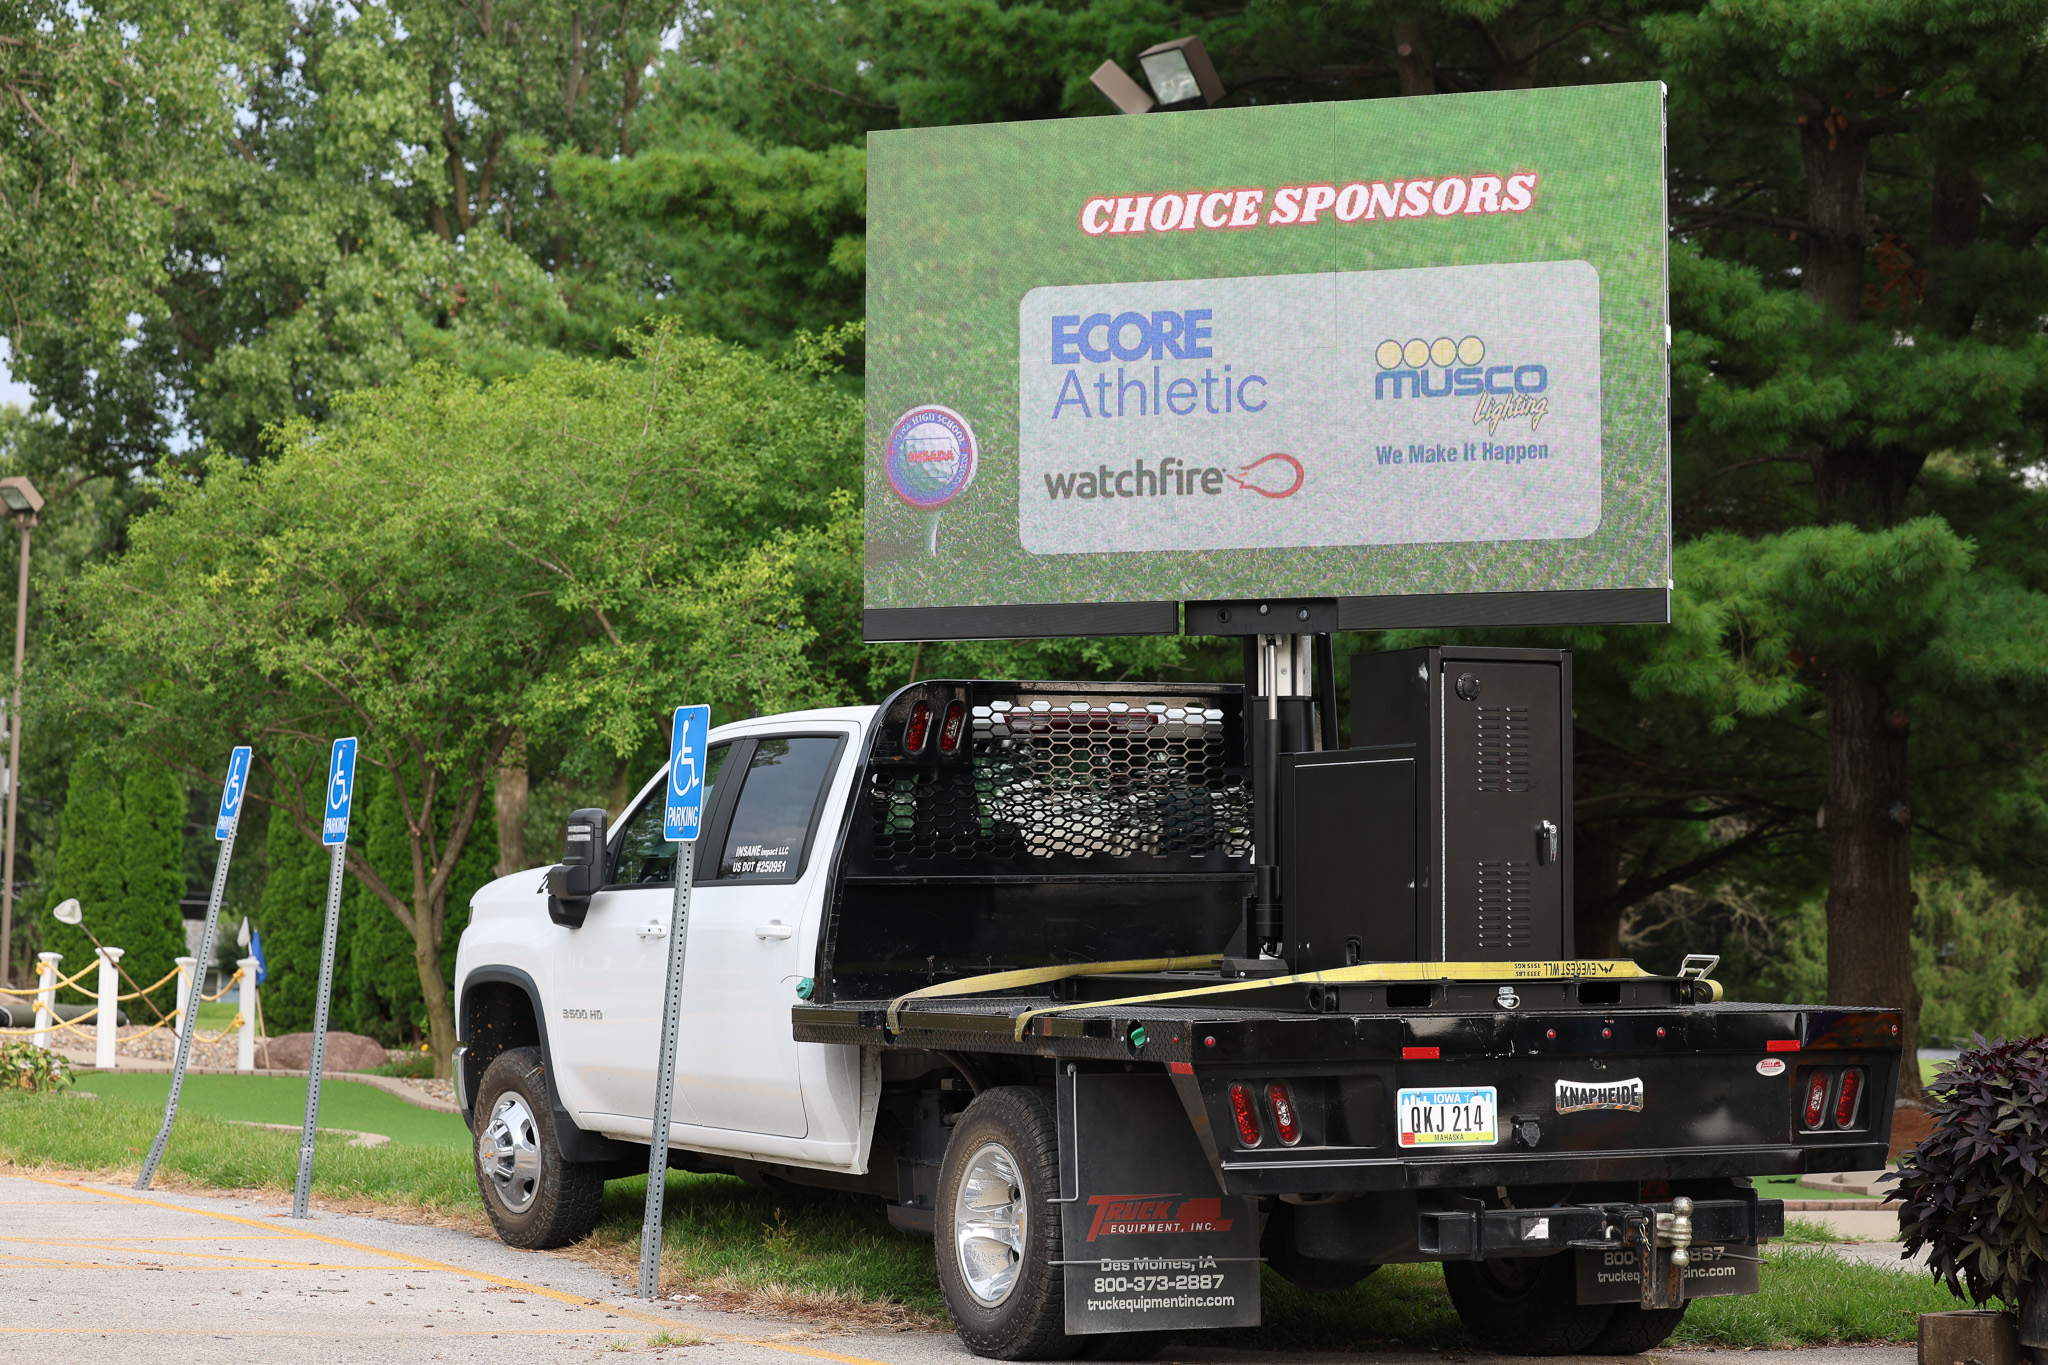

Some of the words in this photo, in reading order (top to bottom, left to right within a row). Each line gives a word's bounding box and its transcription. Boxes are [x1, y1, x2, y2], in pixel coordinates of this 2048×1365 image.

[1079, 189, 1266, 235] CHOICE
[1267, 172, 1538, 226] SPONSORS
[1051, 308, 1213, 365] ECORE
[1051, 364, 1268, 420] Athletic
[1472, 390, 1549, 438] Lighting
[1375, 445, 1403, 465] We
[1408, 443, 1458, 464] Make
[1463, 442, 1477, 462] It
[1482, 441, 1549, 465] Happen
[1043, 457, 1224, 500] watchfire
[325, 817, 347, 834] PARKING
[666, 805, 699, 827] PARKING
[735, 844, 762, 858] INSANE
[761, 847, 779, 858] impact
[778, 846, 790, 855] LLC
[732, 861, 742, 873] US
[742, 861, 756, 872] DOT
[755, 860, 787, 873] #250951
[1543, 962, 1560, 976] WLL
[1561, 962, 1597, 977] EVEREST
[589, 1009, 603, 1020] HD
[1433, 1093, 1462, 1104] IOWA
[1559, 1083, 1639, 1109] KNAPHEIDE
[1411, 1106, 1445, 1133] QKJ
[1452, 1105, 1484, 1132] 214
[1434, 1133, 1465, 1141] MAHASKA
[1086, 1193, 1183, 1242] TRUCK
[1110, 1222, 1185, 1234] EQUIPMENT,
[1190, 1222, 1217, 1232] INC.
[1100, 1257, 1130, 1272] Des
[1133, 1256, 1196, 1272] Moines,
[1199, 1255, 1218, 1269] IA
[1094, 1274, 1225, 1293] 800-373-2887
[1087, 1293, 1236, 1313] truckequipmentinc.com
